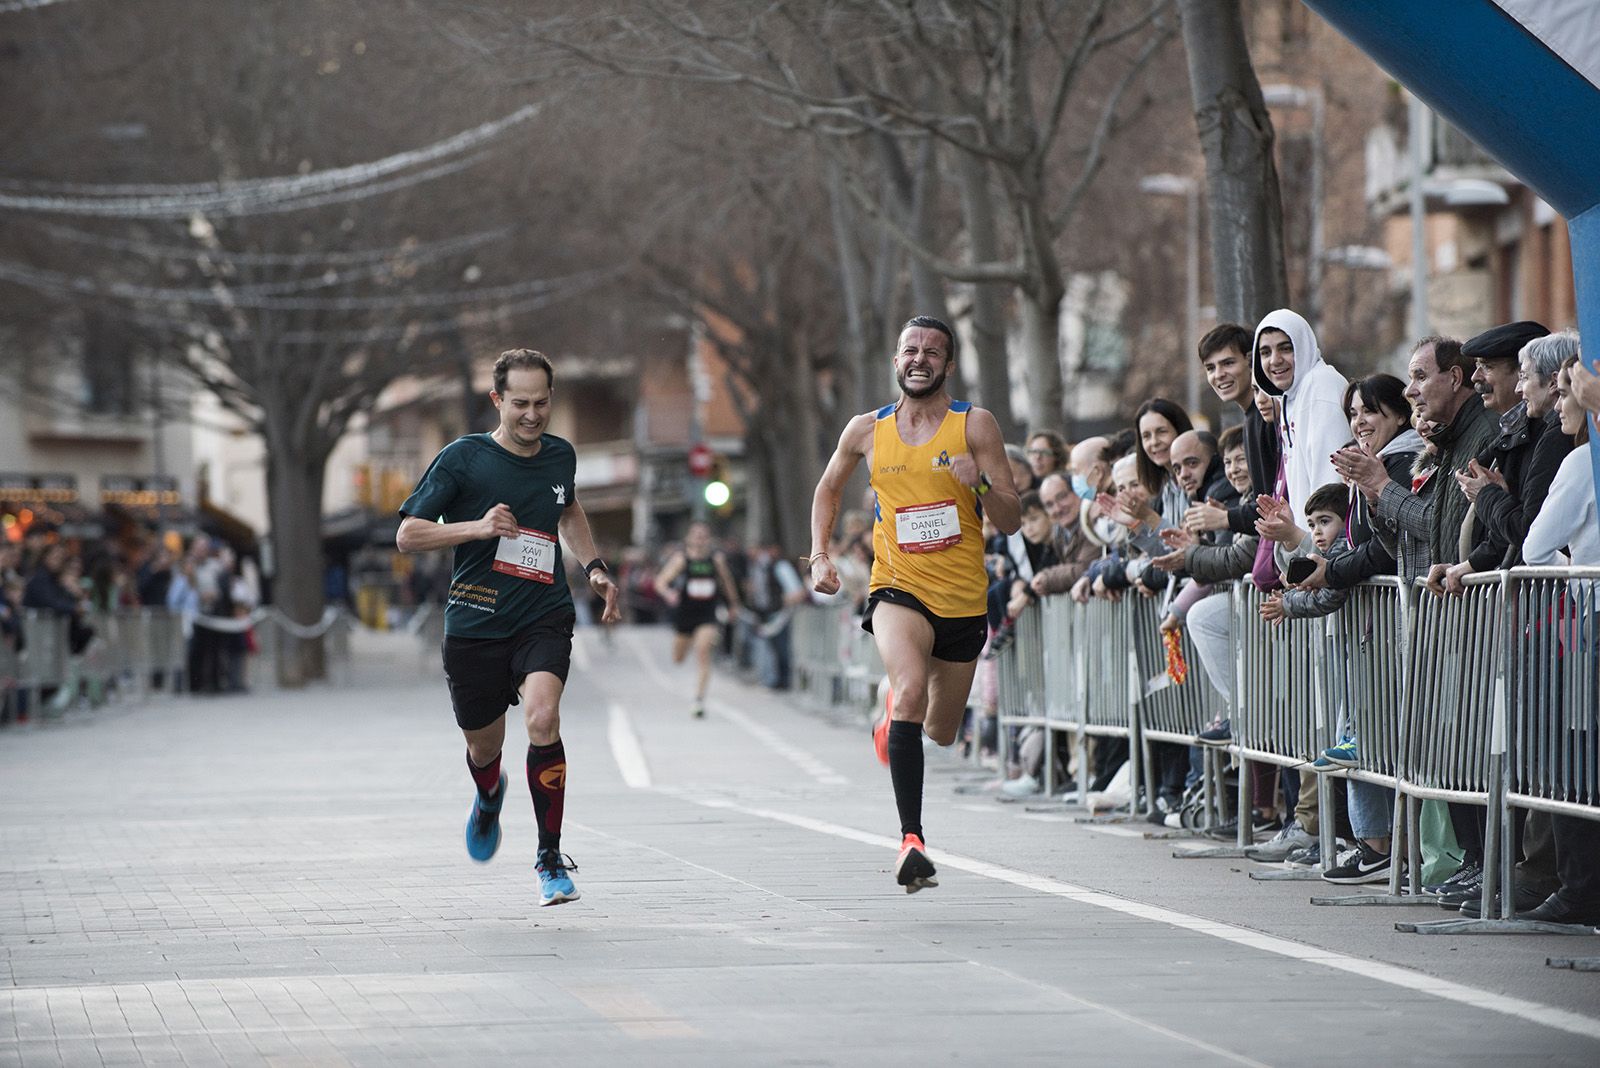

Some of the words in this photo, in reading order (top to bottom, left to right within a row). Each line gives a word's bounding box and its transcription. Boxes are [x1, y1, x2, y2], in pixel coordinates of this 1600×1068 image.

[911, 518, 947, 531] DANIEL
[920, 528, 940, 540] 319
[521, 545, 542, 557] XAVI
[521, 555, 538, 568] 191
